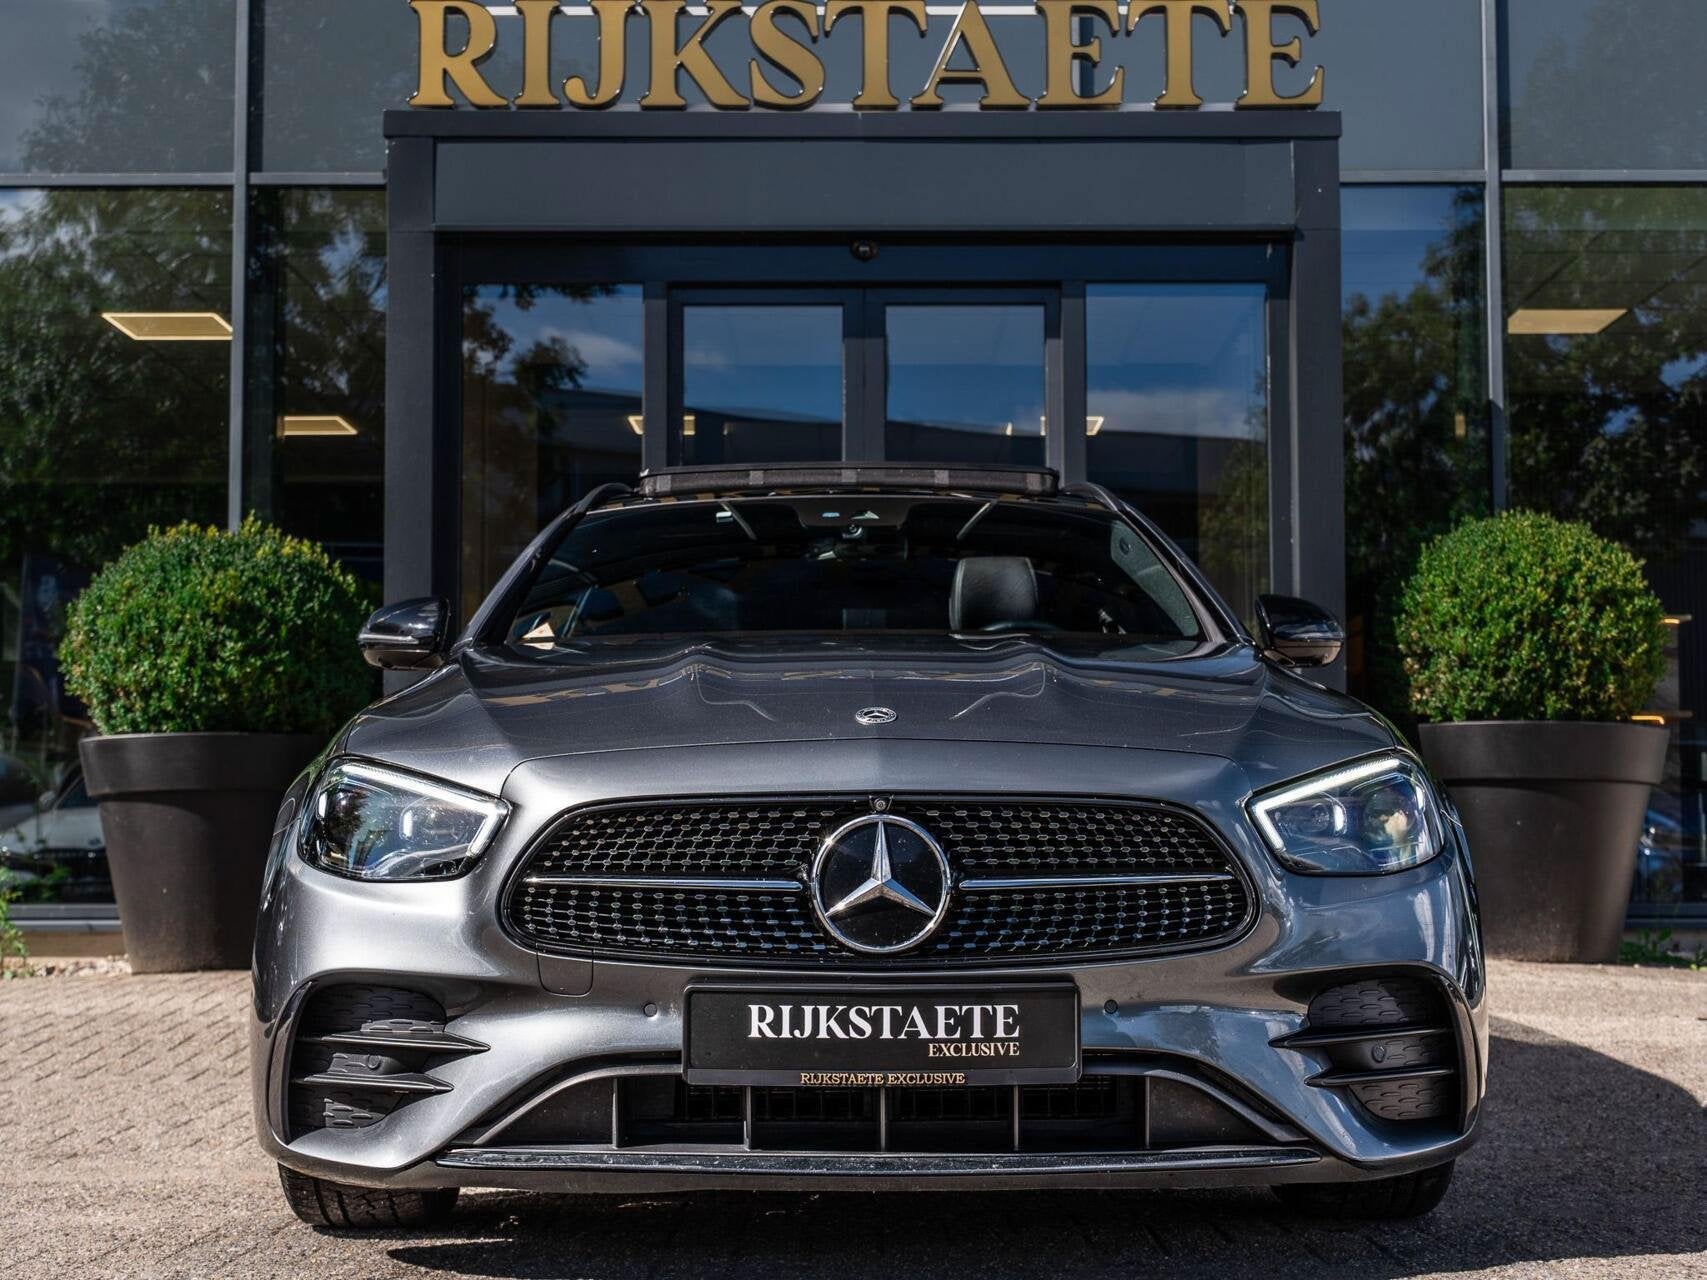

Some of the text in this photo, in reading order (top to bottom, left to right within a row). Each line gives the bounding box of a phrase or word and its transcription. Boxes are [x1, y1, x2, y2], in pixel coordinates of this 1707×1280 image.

[407, 0, 1323, 110] RIJKSTAETE
[748, 1004, 1020, 1039] RIJKSTAETE
[928, 1042, 1020, 1057] EXCLUSIVE
[800, 1072, 965, 1085] RIJKSTAETE EXCLUSIVE
